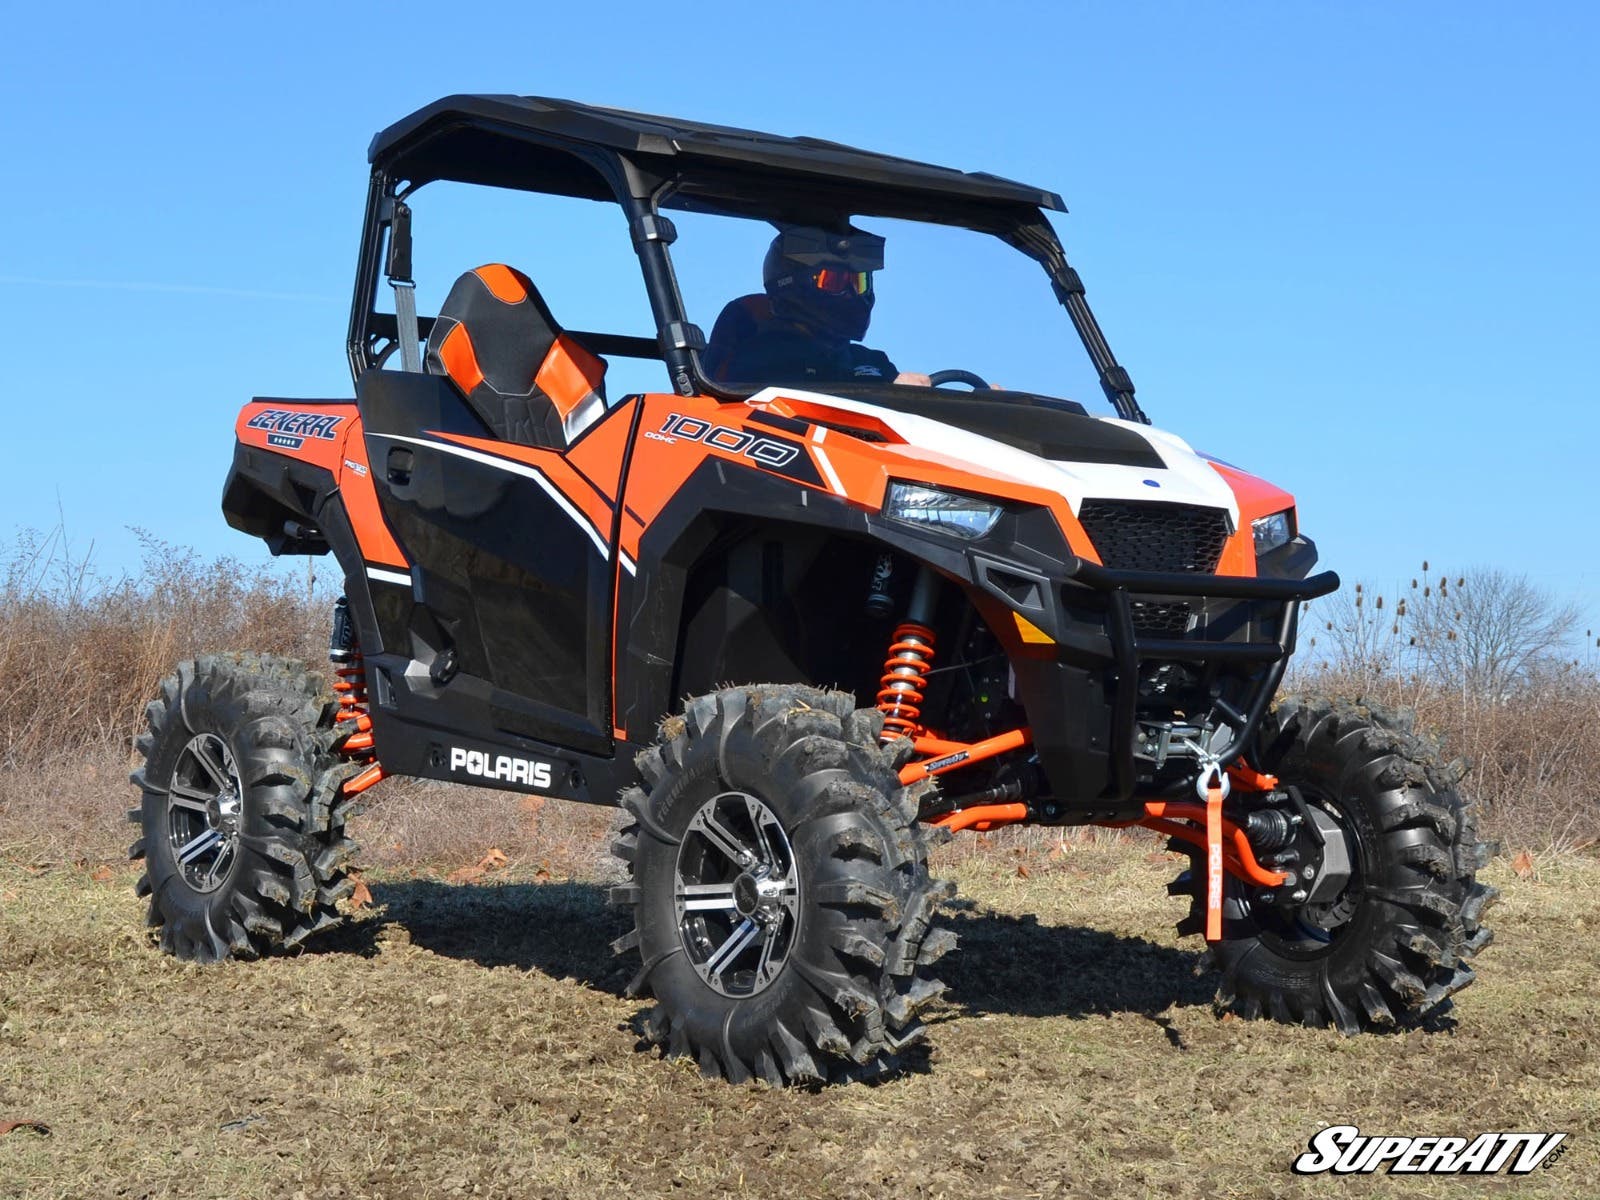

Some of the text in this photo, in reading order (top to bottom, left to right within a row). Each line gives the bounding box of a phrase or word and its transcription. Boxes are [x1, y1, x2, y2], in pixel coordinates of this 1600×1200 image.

[247, 408, 346, 440] GENERAL
[659, 412, 800, 467] 1000
[450, 747, 551, 789] POLARIS
[1209, 843, 1222, 910] POLARIS
